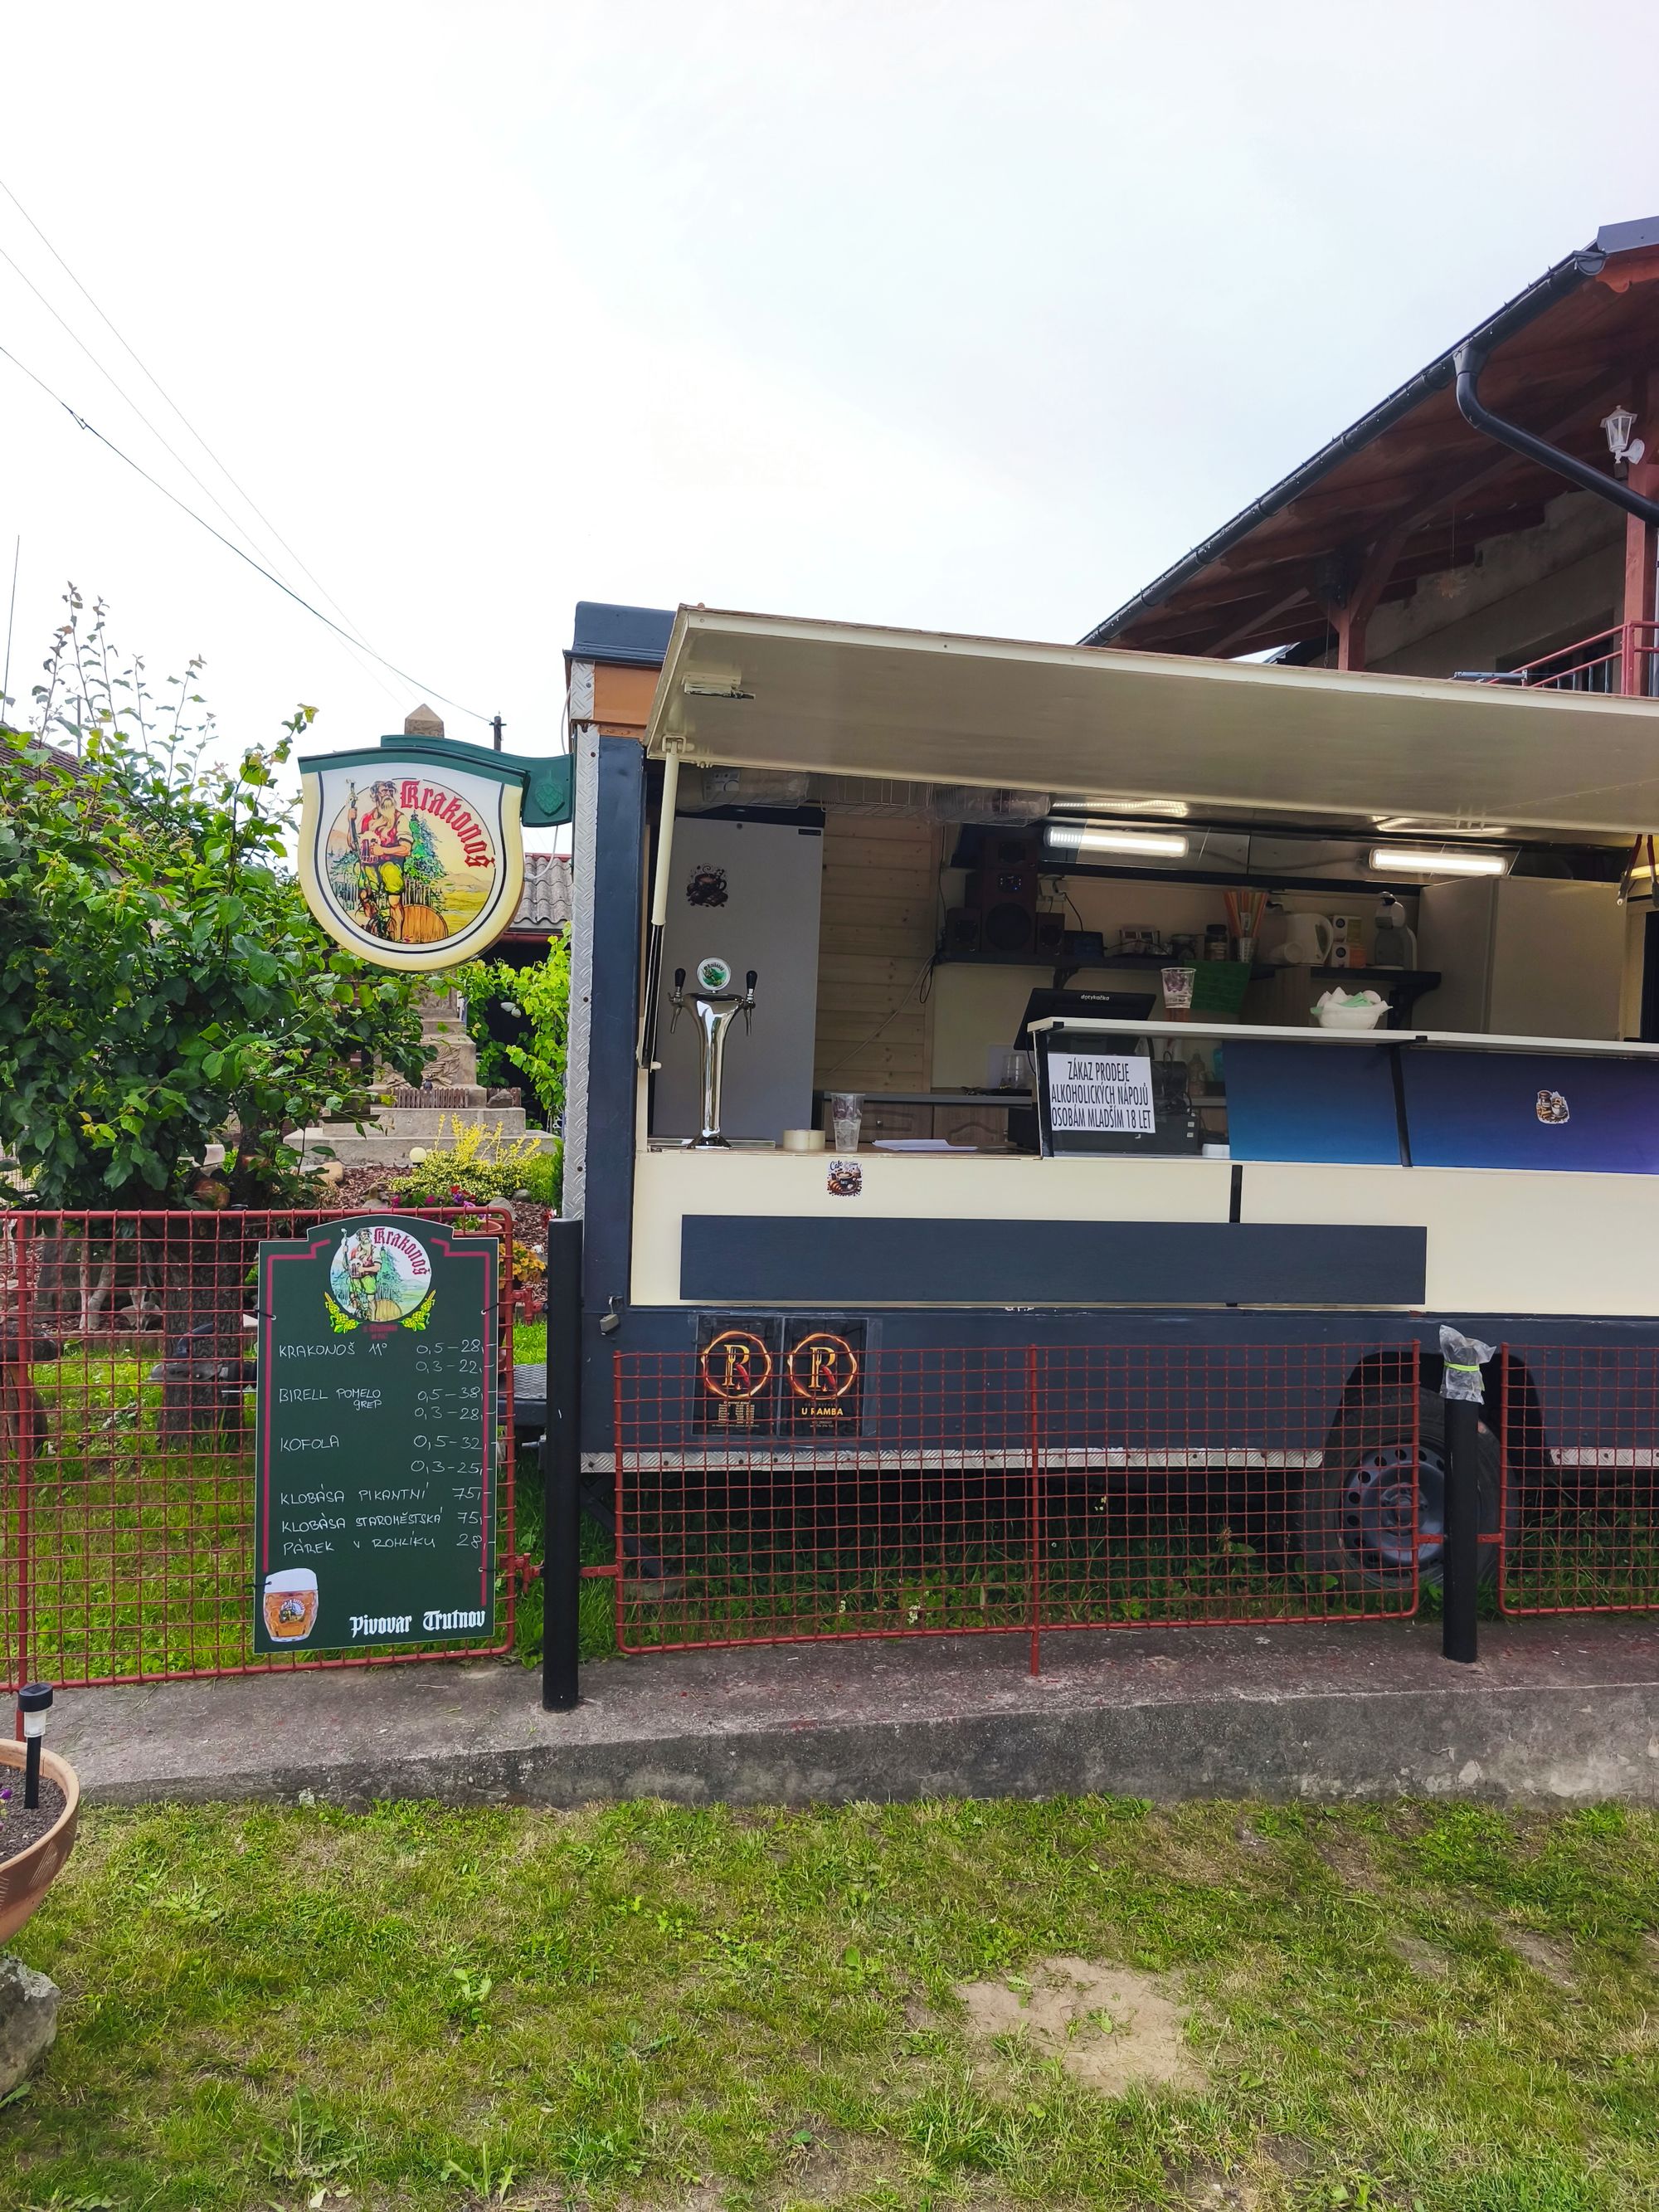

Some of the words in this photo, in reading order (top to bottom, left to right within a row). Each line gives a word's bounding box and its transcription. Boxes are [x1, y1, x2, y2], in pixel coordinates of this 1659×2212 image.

[1068, 1058, 1093, 1080] ZÁKAZ
[1096, 1062, 1130, 1082] PRODEJE
[1051, 1082, 1116, 1105] ALKOHOLICKÝCH
[1118, 1083, 1149, 1106] NÁPOJŮ
[1052, 1104, 1086, 1127] OSOBÁM
[1087, 1106, 1124, 1128] MLADŠÍM
[1126, 1110, 1136, 1128] 18
[1139, 1110, 1151, 1129] LET
[374, 1227, 431, 1275] Krakonoš
[280, 1341, 355, 1358] KRAKONOŠ
[280, 1388, 328, 1404] BIRELL
[336, 1388, 381, 1400] POMELO
[801, 1407, 808, 1415] U
[280, 1435, 339, 1452] KOFOLA
[280, 1483, 345, 1505] KLOBÁSA
[358, 1481, 429, 1502] PIKANTNÍ
[282, 1512, 346, 1532] KLOBÁSA
[283, 1537, 335, 1557] PÁREK
[349, 1614, 412, 1638] Pivovar
[422, 1609, 486, 1631] Trutnov
